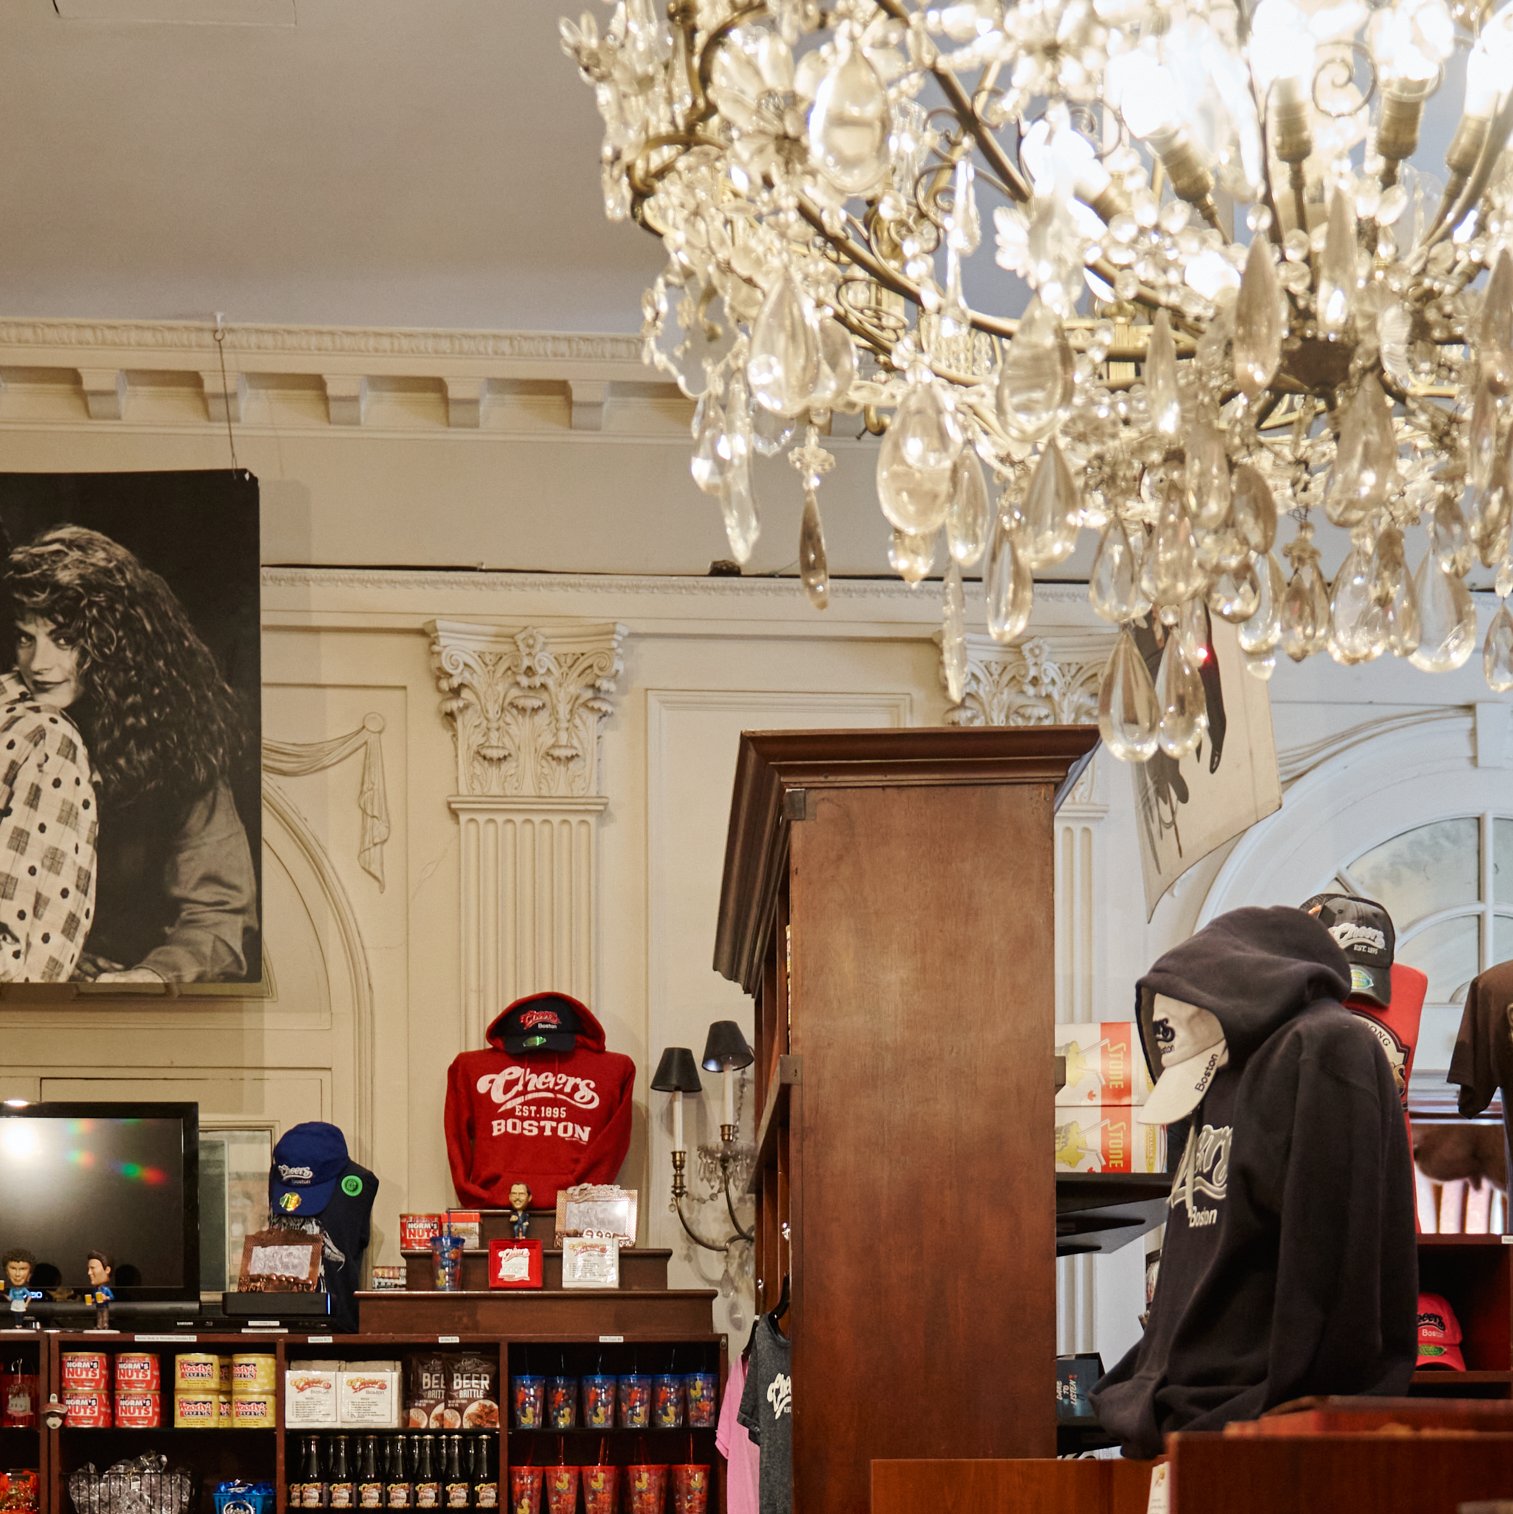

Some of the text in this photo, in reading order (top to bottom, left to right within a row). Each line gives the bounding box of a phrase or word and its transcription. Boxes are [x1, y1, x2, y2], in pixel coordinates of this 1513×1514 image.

[1194, 1053, 1219, 1092] Boston
[476, 1065, 600, 1113] Cheers
[492, 1118, 591, 1142] BOSTON
[278, 1164, 314, 1181] Cheers
[1187, 1205, 1218, 1228] Boston
[407, 1221, 439, 1230] NORM'S
[407, 1229, 439, 1239] NUTS
[1422, 1328, 1444, 1338] Boston
[66, 1360, 99, 1370] NORM'S
[118, 1361, 150, 1370] NORM'S
[179, 1363, 214, 1373] Woody's
[233, 1364, 257, 1374] oody's
[67, 1369, 98, 1379] NUTS
[118, 1370, 149, 1379] NUTS
[422, 1373, 446, 1389] BEE
[453, 1373, 490, 1390] BEER
[427, 1390, 445, 1398] BRITT
[459, 1389, 484, 1398] BRITTLE
[1069, 1379, 1078, 1406] LISTEN
[65, 1398, 98, 1407] NORM'S
[119, 1398, 151, 1407] NORM'S
[179, 1402, 213, 1412] Woody's
[234, 1402, 267, 1411] Woody's
[66, 1406, 97, 1415] NUTS
[119, 1406, 150, 1416] NUTS
